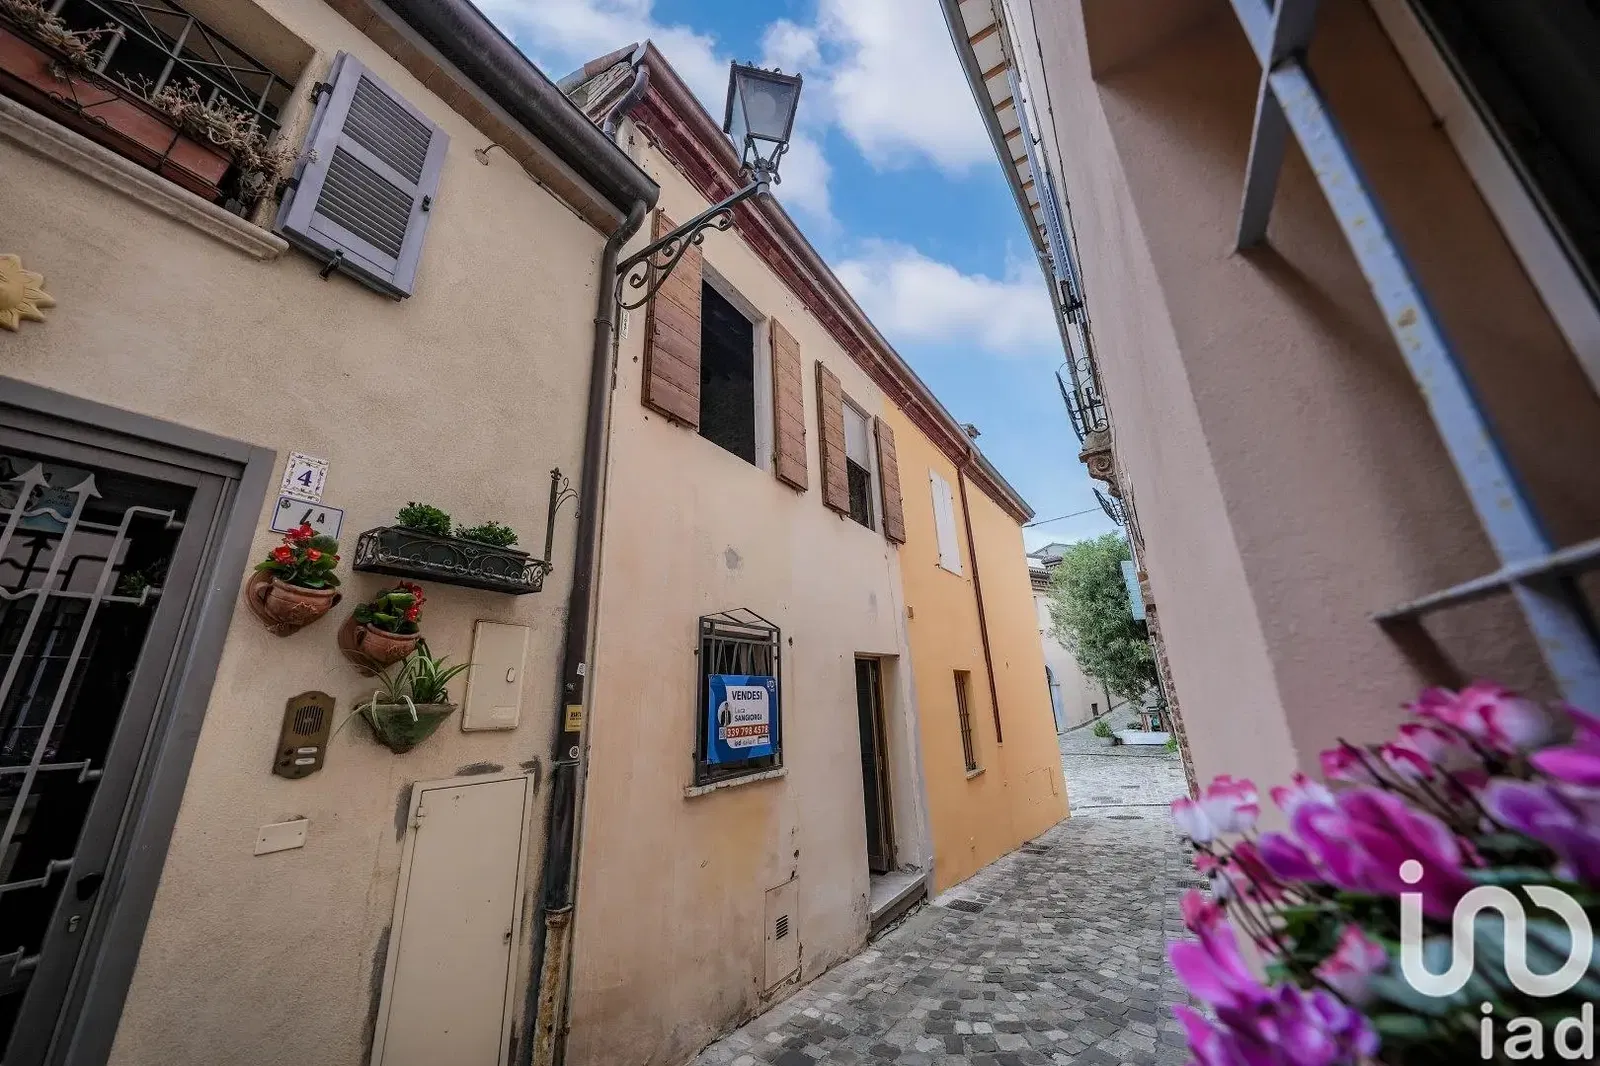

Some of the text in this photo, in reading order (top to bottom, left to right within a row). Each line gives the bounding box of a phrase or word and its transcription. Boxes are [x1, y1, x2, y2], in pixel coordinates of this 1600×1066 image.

[297, 470, 312, 487] 4
[731, 690, 763, 701] VENDESI
[727, 725, 769, 737] 339 798 4578
